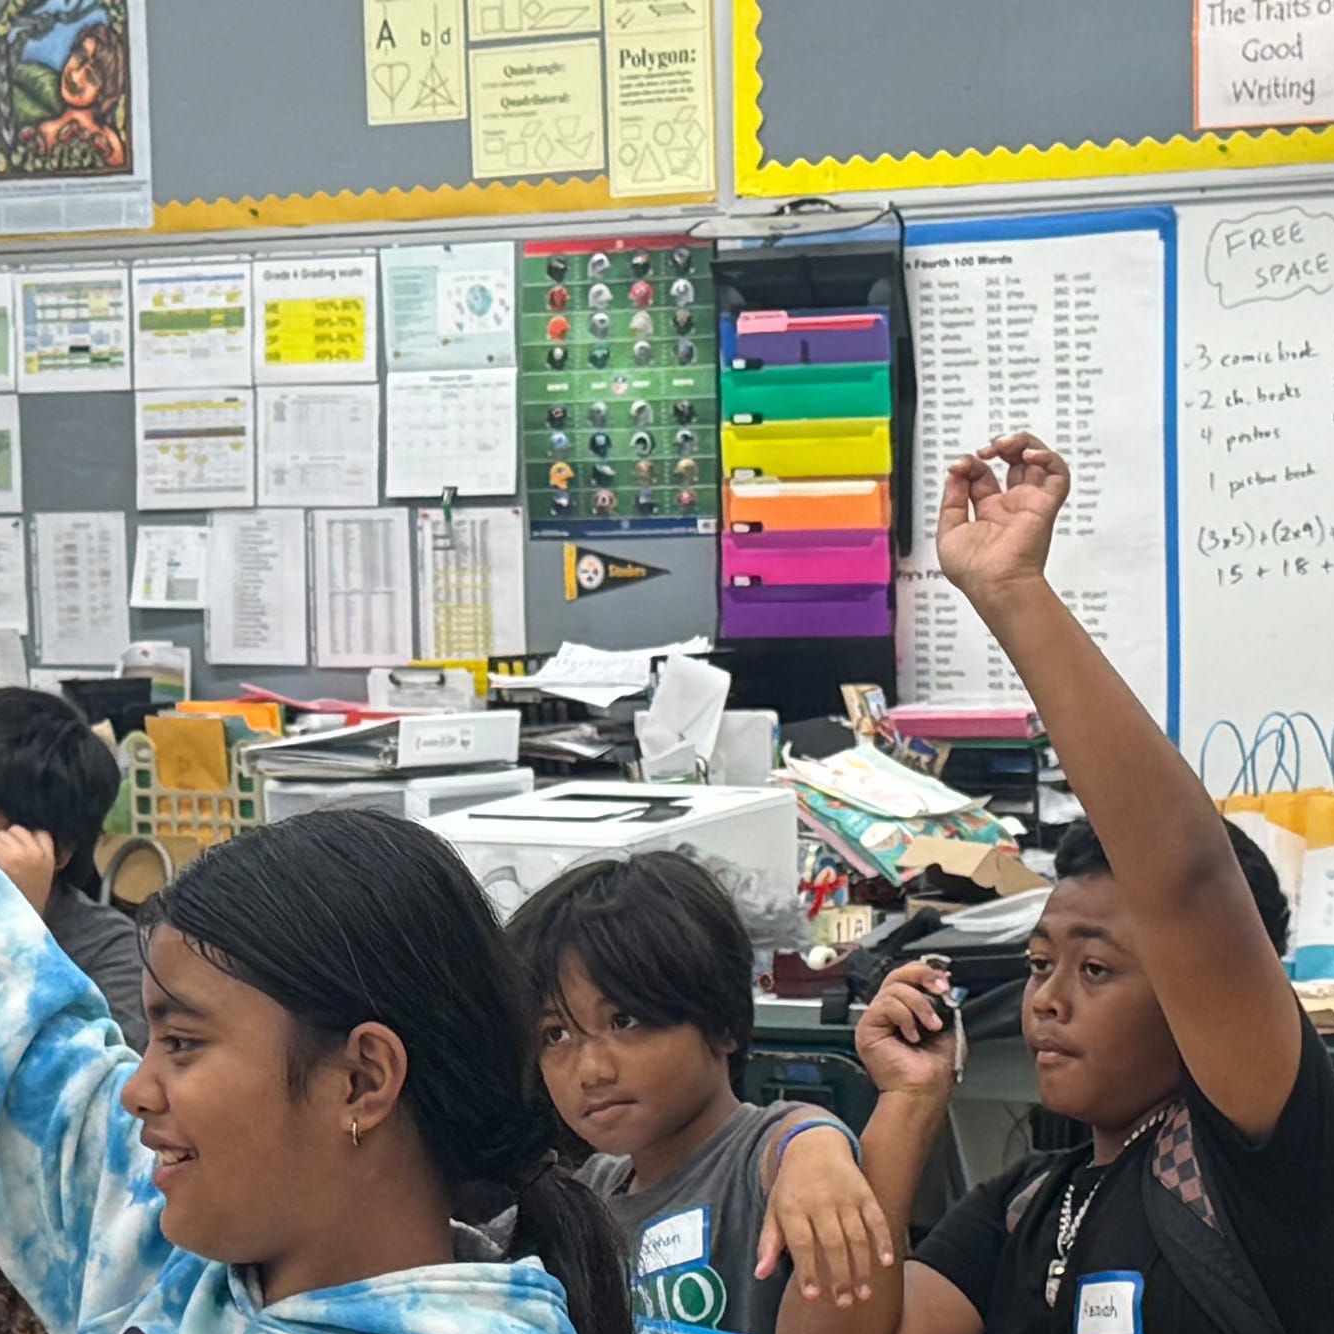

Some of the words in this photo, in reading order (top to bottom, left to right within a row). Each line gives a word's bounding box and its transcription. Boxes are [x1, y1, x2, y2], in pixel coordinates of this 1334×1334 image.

[1207, 3, 1245, 27] The
[1254, 0, 1311, 23] Traits
[376, 19, 396, 50] A
[1242, 33, 1303, 63] Good
[620, 48, 697, 71] Polygon:
[1232, 77, 1315, 105] Writing
[1225, 222, 1304, 257] FREE
[1256, 253, 1329, 289] SPACE
